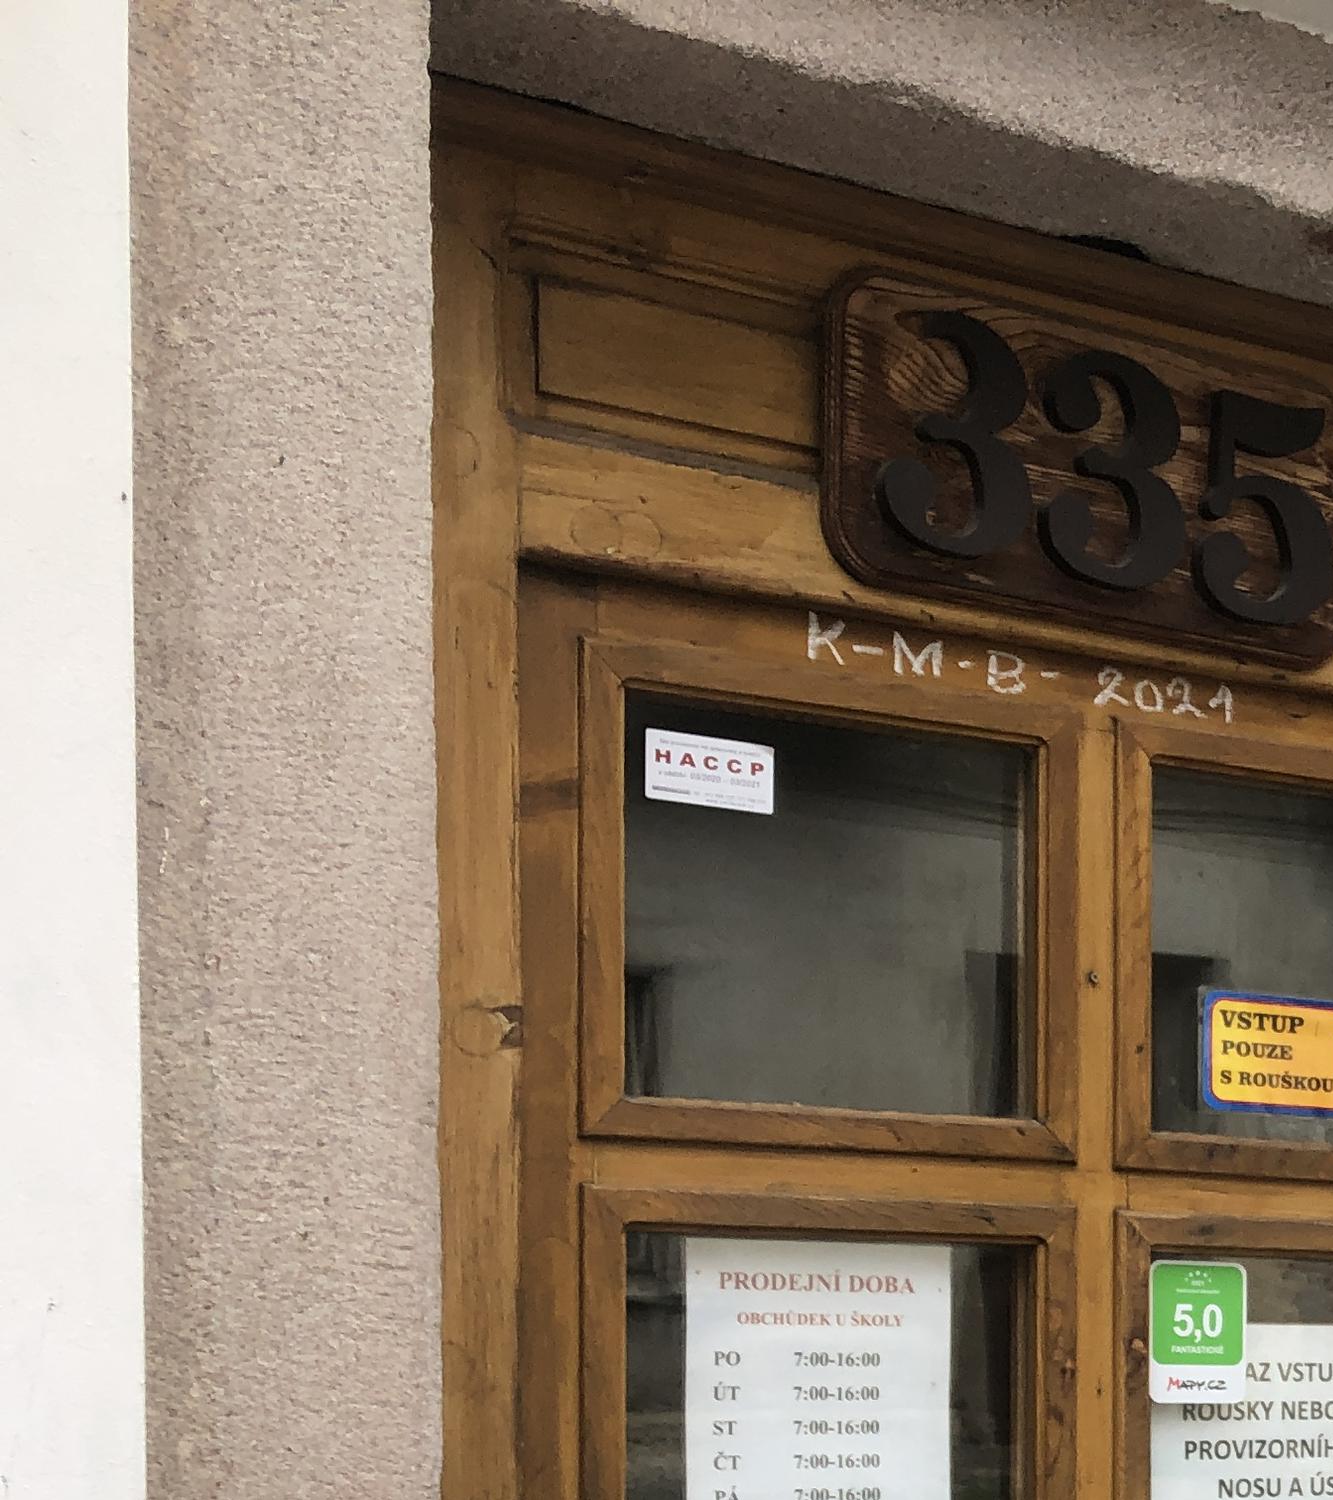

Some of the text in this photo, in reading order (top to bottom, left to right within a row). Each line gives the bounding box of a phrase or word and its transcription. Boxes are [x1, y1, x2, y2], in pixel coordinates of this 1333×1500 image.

[1094, 666, 1233, 723] 2021
[655, 748, 764, 776] HACCP
[1219, 1008, 1304, 1034] VSTUP
[1221, 1039, 1293, 1060] POUZE
[1220, 1069, 1333, 1093] S ROUŠKOU
[719, 1269, 915, 1294] PRODEJNÍ DOBA
[836, 1313, 846, 1326] U
[850, 1310, 904, 1328] ŠKOLY
[1172, 1303, 1223, 1343] 5,0
[713, 1350, 881, 1368] PO 7:00-16:00
[713, 1381, 880, 1402] ÚT 7:00-16:00
[712, 1420, 880, 1436] ST 7:00-16:00
[713, 1451, 880, 1471] ČT 7:00-16:00
[1218, 1478, 1281, 1499] NOSU
[1289, 1477, 1303, 1497] A
